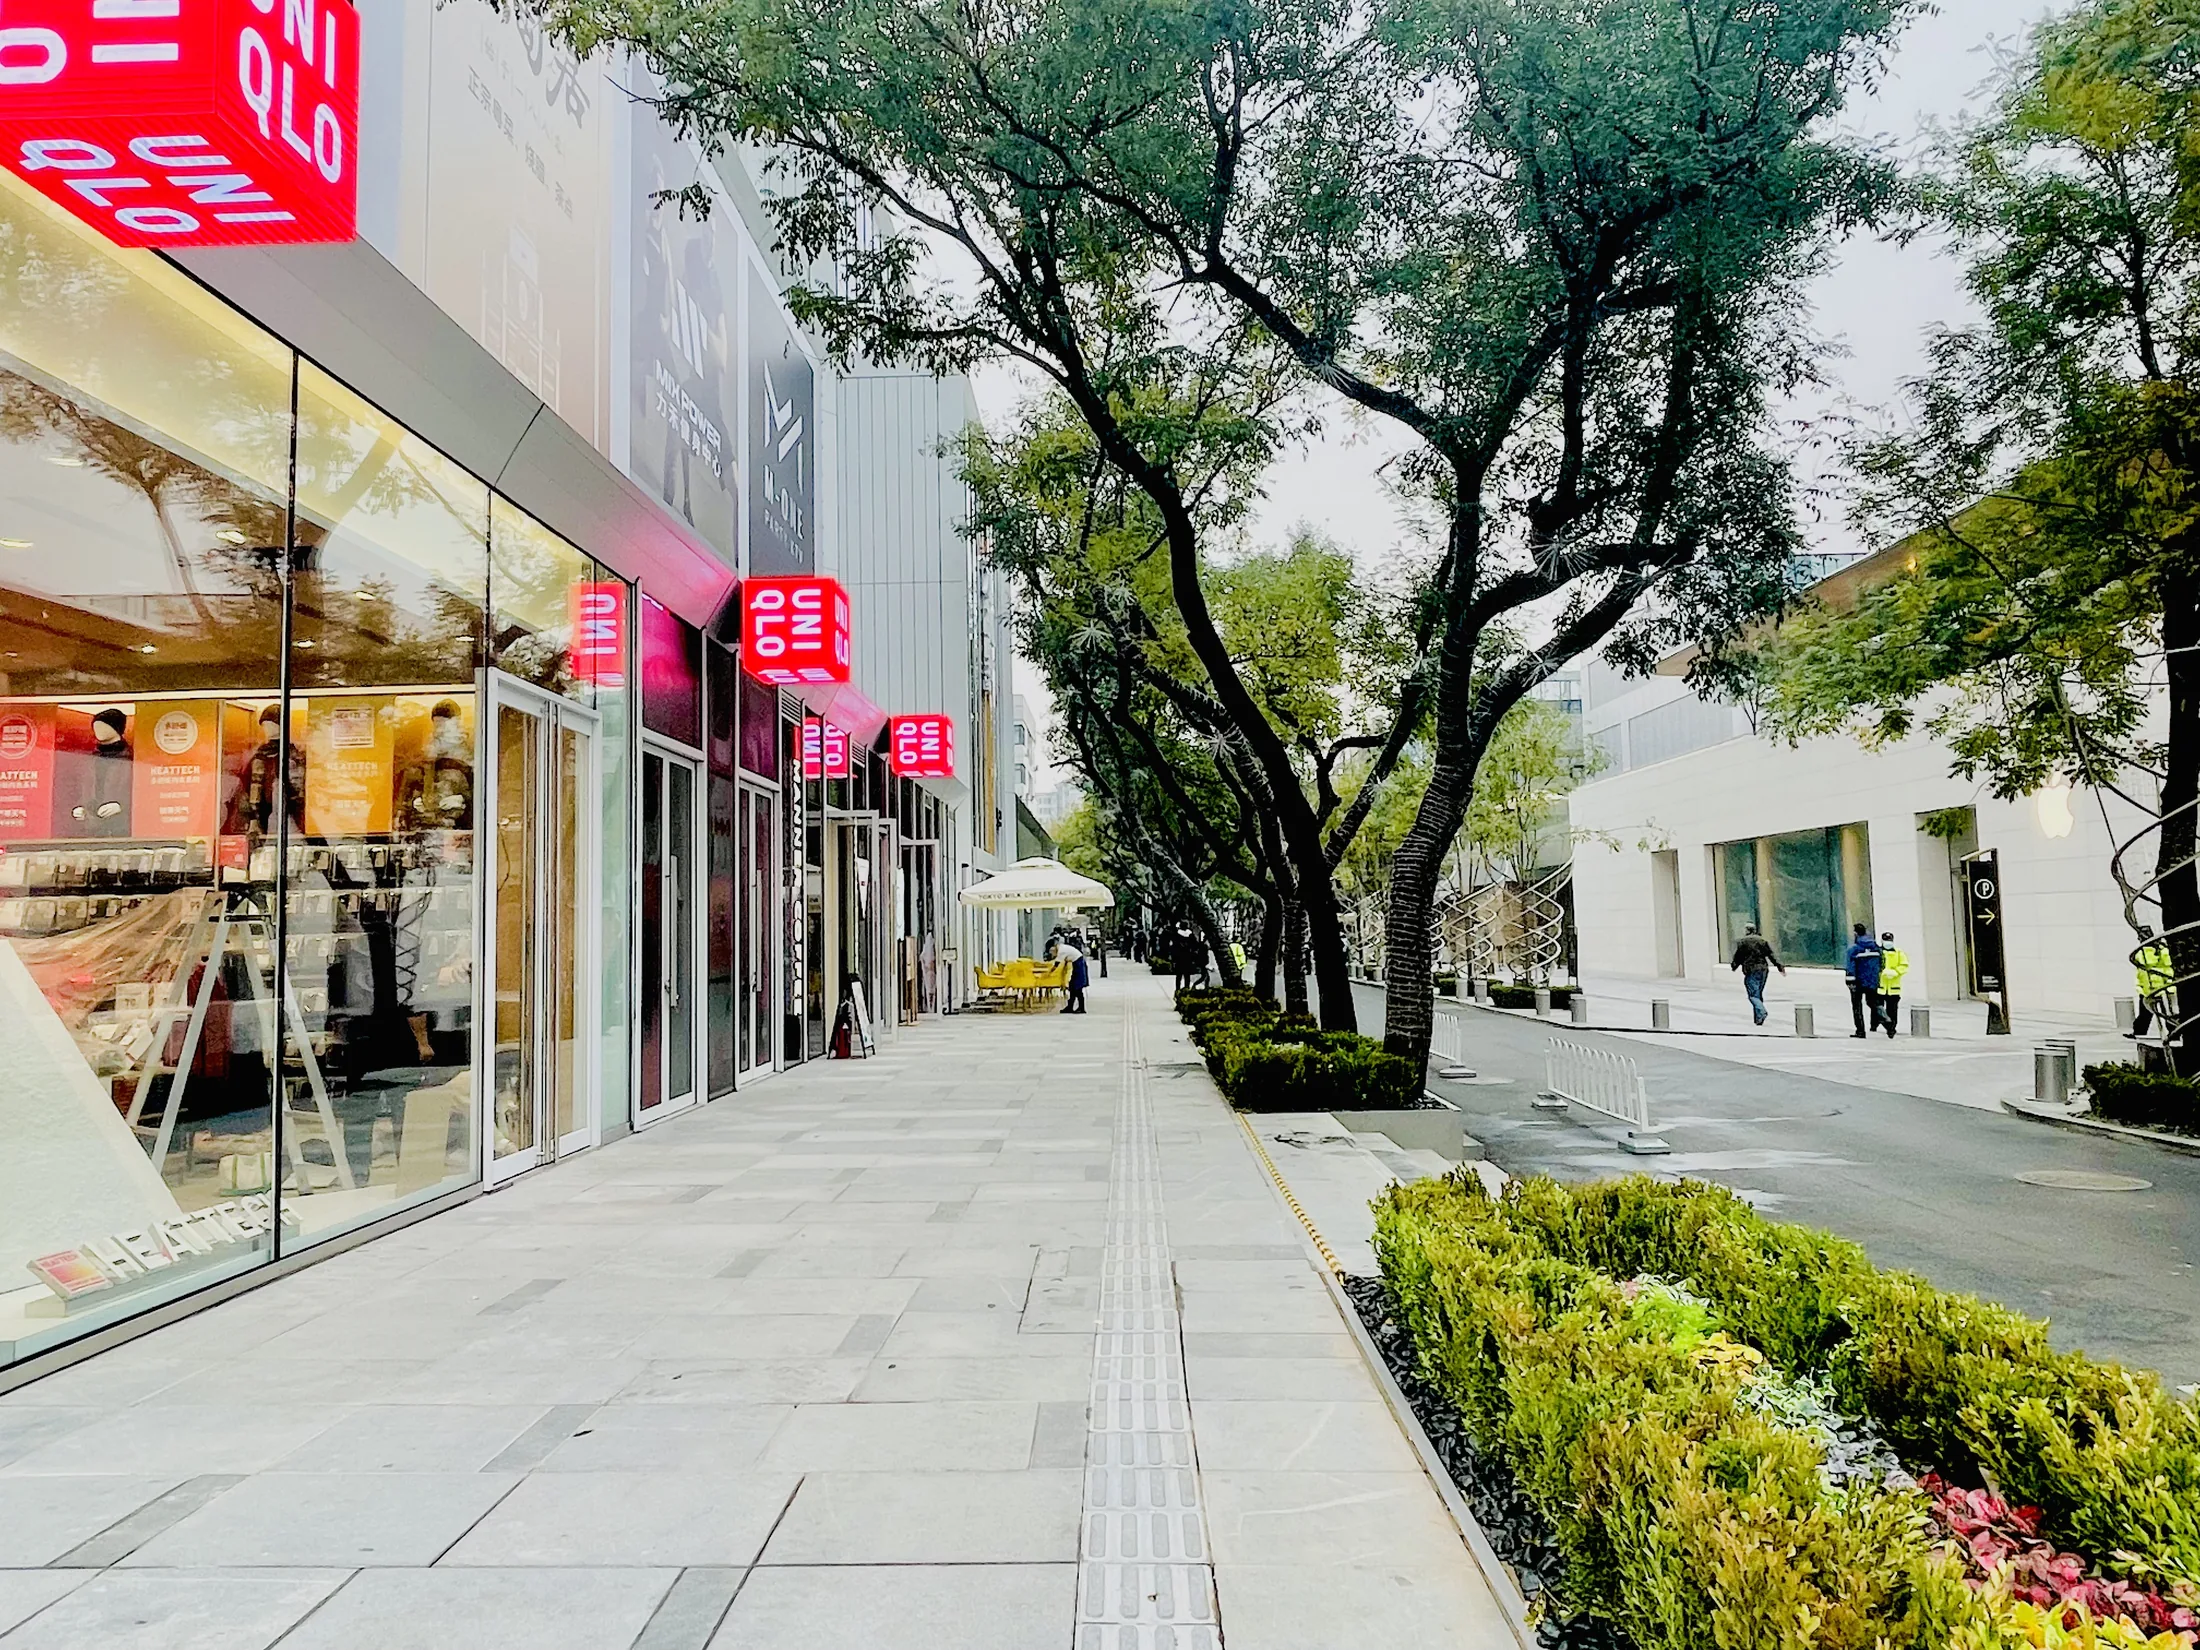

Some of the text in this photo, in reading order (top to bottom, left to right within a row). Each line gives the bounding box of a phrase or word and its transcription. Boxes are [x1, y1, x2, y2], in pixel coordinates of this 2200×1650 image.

[239, 26, 342, 184] QLO
[19, 138, 201, 234] QLO
[128, 135, 297, 223] UNI
[750, 589, 786, 657] QLO
[791, 588, 822, 650] UNI
[151, 766, 200, 776] HEATTECH
[895, 722, 918, 765] QLO
[921, 721, 940, 760] UNI
